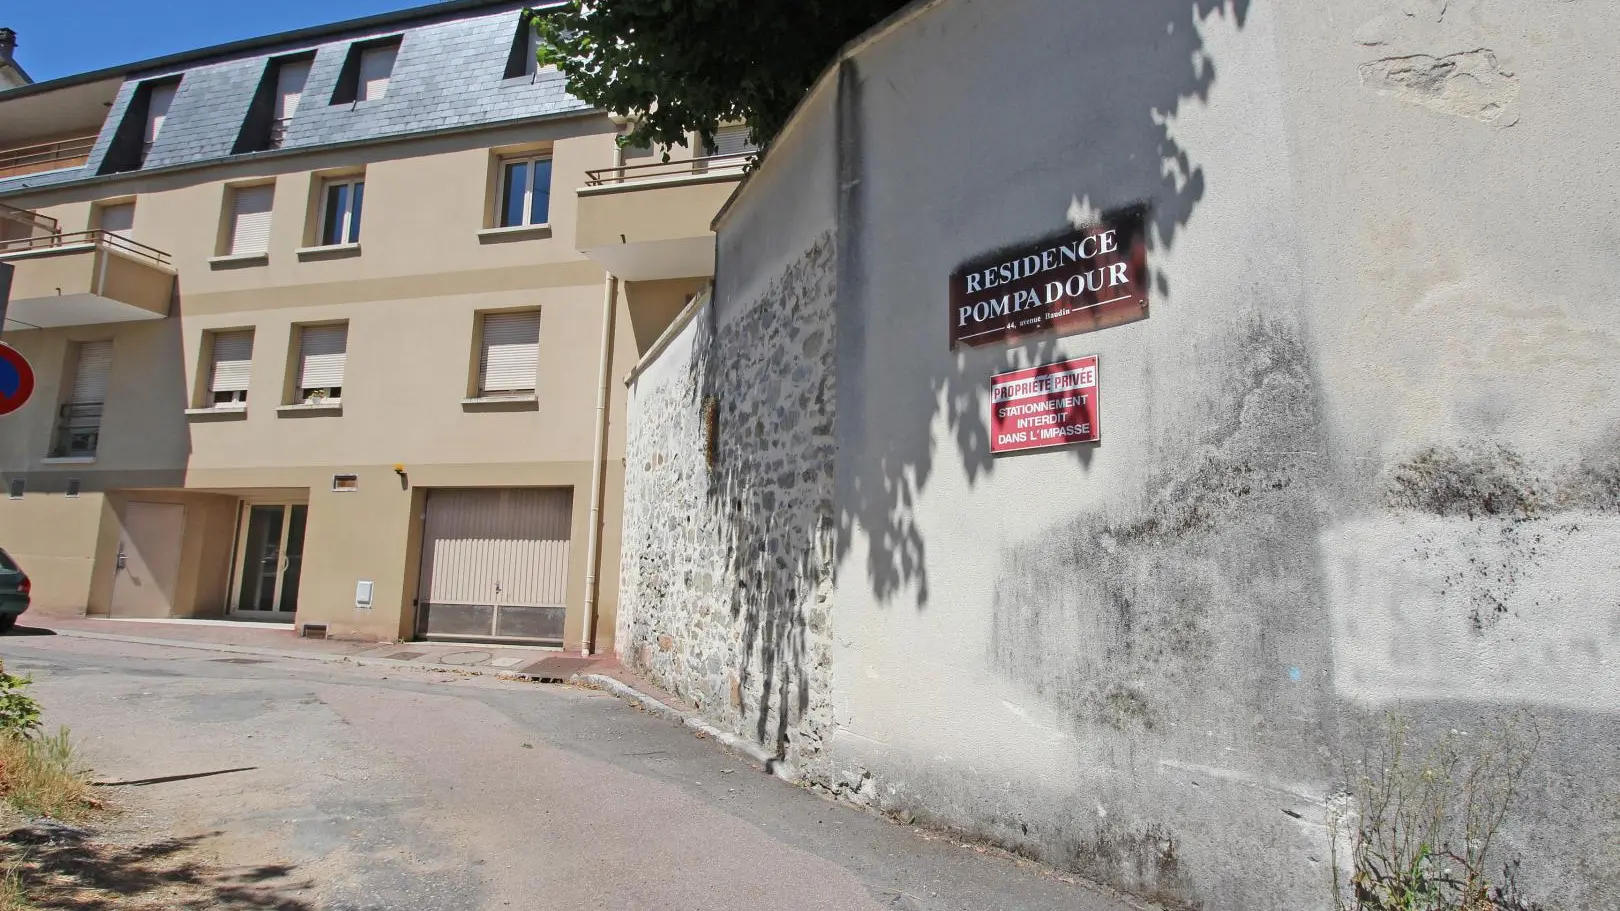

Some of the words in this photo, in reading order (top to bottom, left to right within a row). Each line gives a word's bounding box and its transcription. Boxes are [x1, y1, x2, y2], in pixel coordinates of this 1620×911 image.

[966, 229, 1118, 294] RESIDENCE
[958, 262, 1130, 327] POMPADOUR
[1020, 316, 1042, 326] avenue
[1045, 308, 1071, 320] Baudin
[1055, 367, 1093, 389] PRIVÉE
[998, 394, 1089, 418] STATIONNEMENT
[1017, 412, 1068, 429] INTERDIT
[998, 432, 1027, 445] DANS
[1030, 423, 1090, 440] L'IMPASSE
